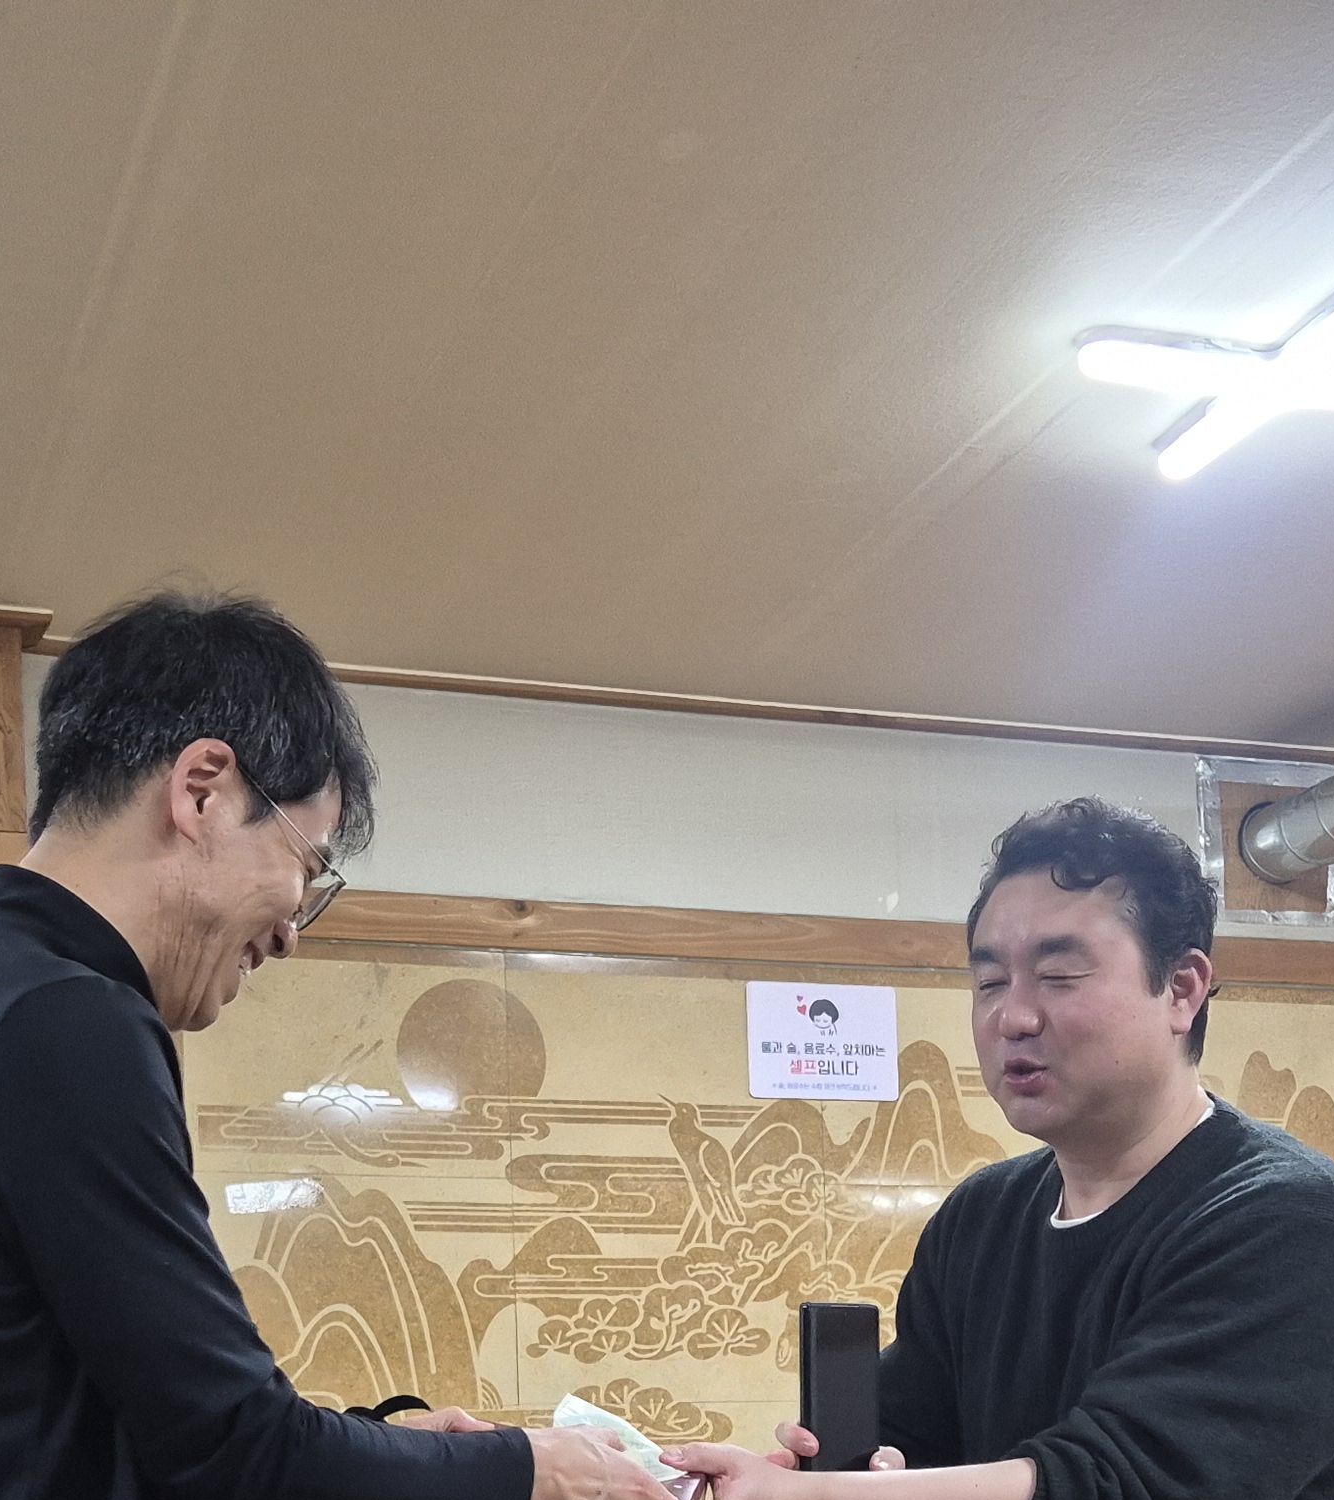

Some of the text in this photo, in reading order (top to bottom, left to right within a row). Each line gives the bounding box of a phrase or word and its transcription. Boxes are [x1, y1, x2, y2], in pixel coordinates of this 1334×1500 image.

[761, 1041, 783, 1054] 물과
[803, 1042, 840, 1057] 음료수,
[842, 1043, 886, 1057] 앞치마는
[789, 1059, 859, 1076] 셀프입니다
